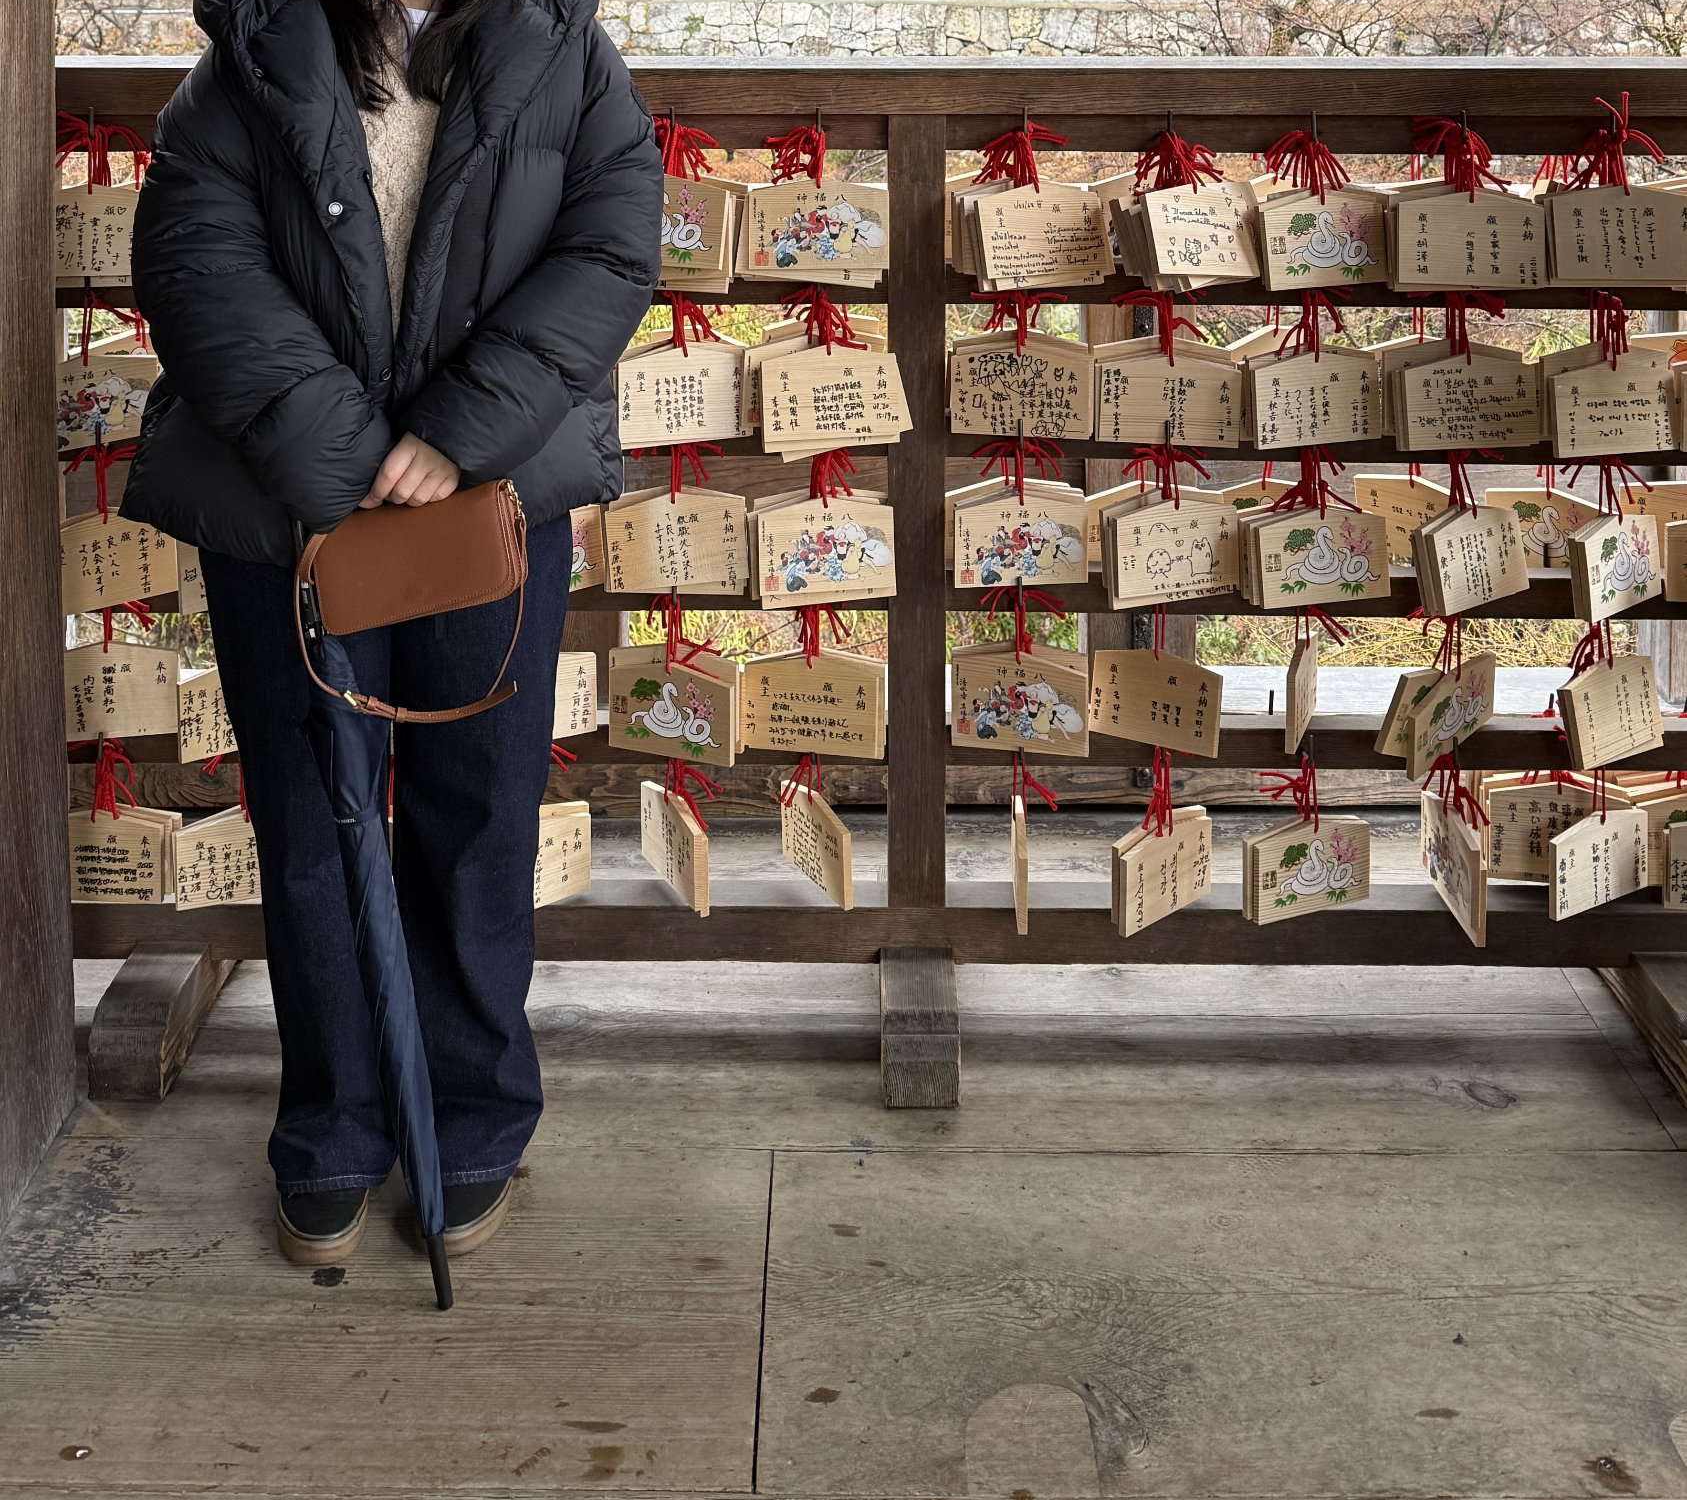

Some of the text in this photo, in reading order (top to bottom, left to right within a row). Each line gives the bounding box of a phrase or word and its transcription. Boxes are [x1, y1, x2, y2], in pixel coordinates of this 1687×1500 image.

[1486, 215, 1498, 225] 願
[1573, 207, 1584, 229] 願主
[1643, 207, 1655, 217] 願
[1418, 213, 1428, 234] 願主
[1522, 216, 1534, 241] 奉納
[636, 371, 646, 393] 願主
[699, 368, 709, 378] 願
[780, 371, 790, 393] 願主
[843, 367, 854, 377] 願
[877, 365, 886, 389] 奉納
[1068, 371, 1077, 395] 奉納
[1330, 372, 1339, 383] 願
[1360, 370, 1370, 395] 奉納
[1484, 376, 1494, 386] 願
[1120, 375, 1129, 396] 願主
[1185, 379, 1196, 389] 願
[1219, 381, 1230, 404] 奉納
[1272, 377, 1281, 399] 願主
[1423, 379, 1432, 400] 願主
[1517, 374, 1527, 400] 奉納
[1627, 382, 1637, 392] 願
[1657, 380, 1667, 404] 奉納
[1571, 386, 1581, 407] 願主
[688, 513, 700, 523] 願
[723, 509, 734, 533] 奉納
[1219, 516, 1229, 541] 奉納
[120, 531, 132, 542] 願
[624, 521, 635, 542] 願主
[78, 544, 92, 576] ように
[107, 535, 121, 577] 良い人に
[91, 539, 105, 596] 出会えます
[120, 663, 131, 673] 願
[156, 661, 167, 684] 奉納
[577, 665, 587, 690] 奉納
[1109, 663, 1119, 686] 願主
[84, 675, 95, 703] 内定を
[761, 676, 770, 697] 願主
[822, 682, 833, 692] 願
[1167, 676, 1178, 686] 願
[198, 689, 208, 711] 願主
[855, 685, 866, 710] 奉納
[1198, 681, 1209, 708] 奉納
[571, 692, 581, 730] 二月二十一日
[582, 690, 592, 728] 二〇二五年
[1507, 802, 1518, 823] 願主
[106, 835, 117, 845] 願
[140, 835, 151, 860] 奉納
[545, 837, 554, 847] 願
[573, 828, 582, 852] 奉納
[195, 841, 206, 862] 願主
